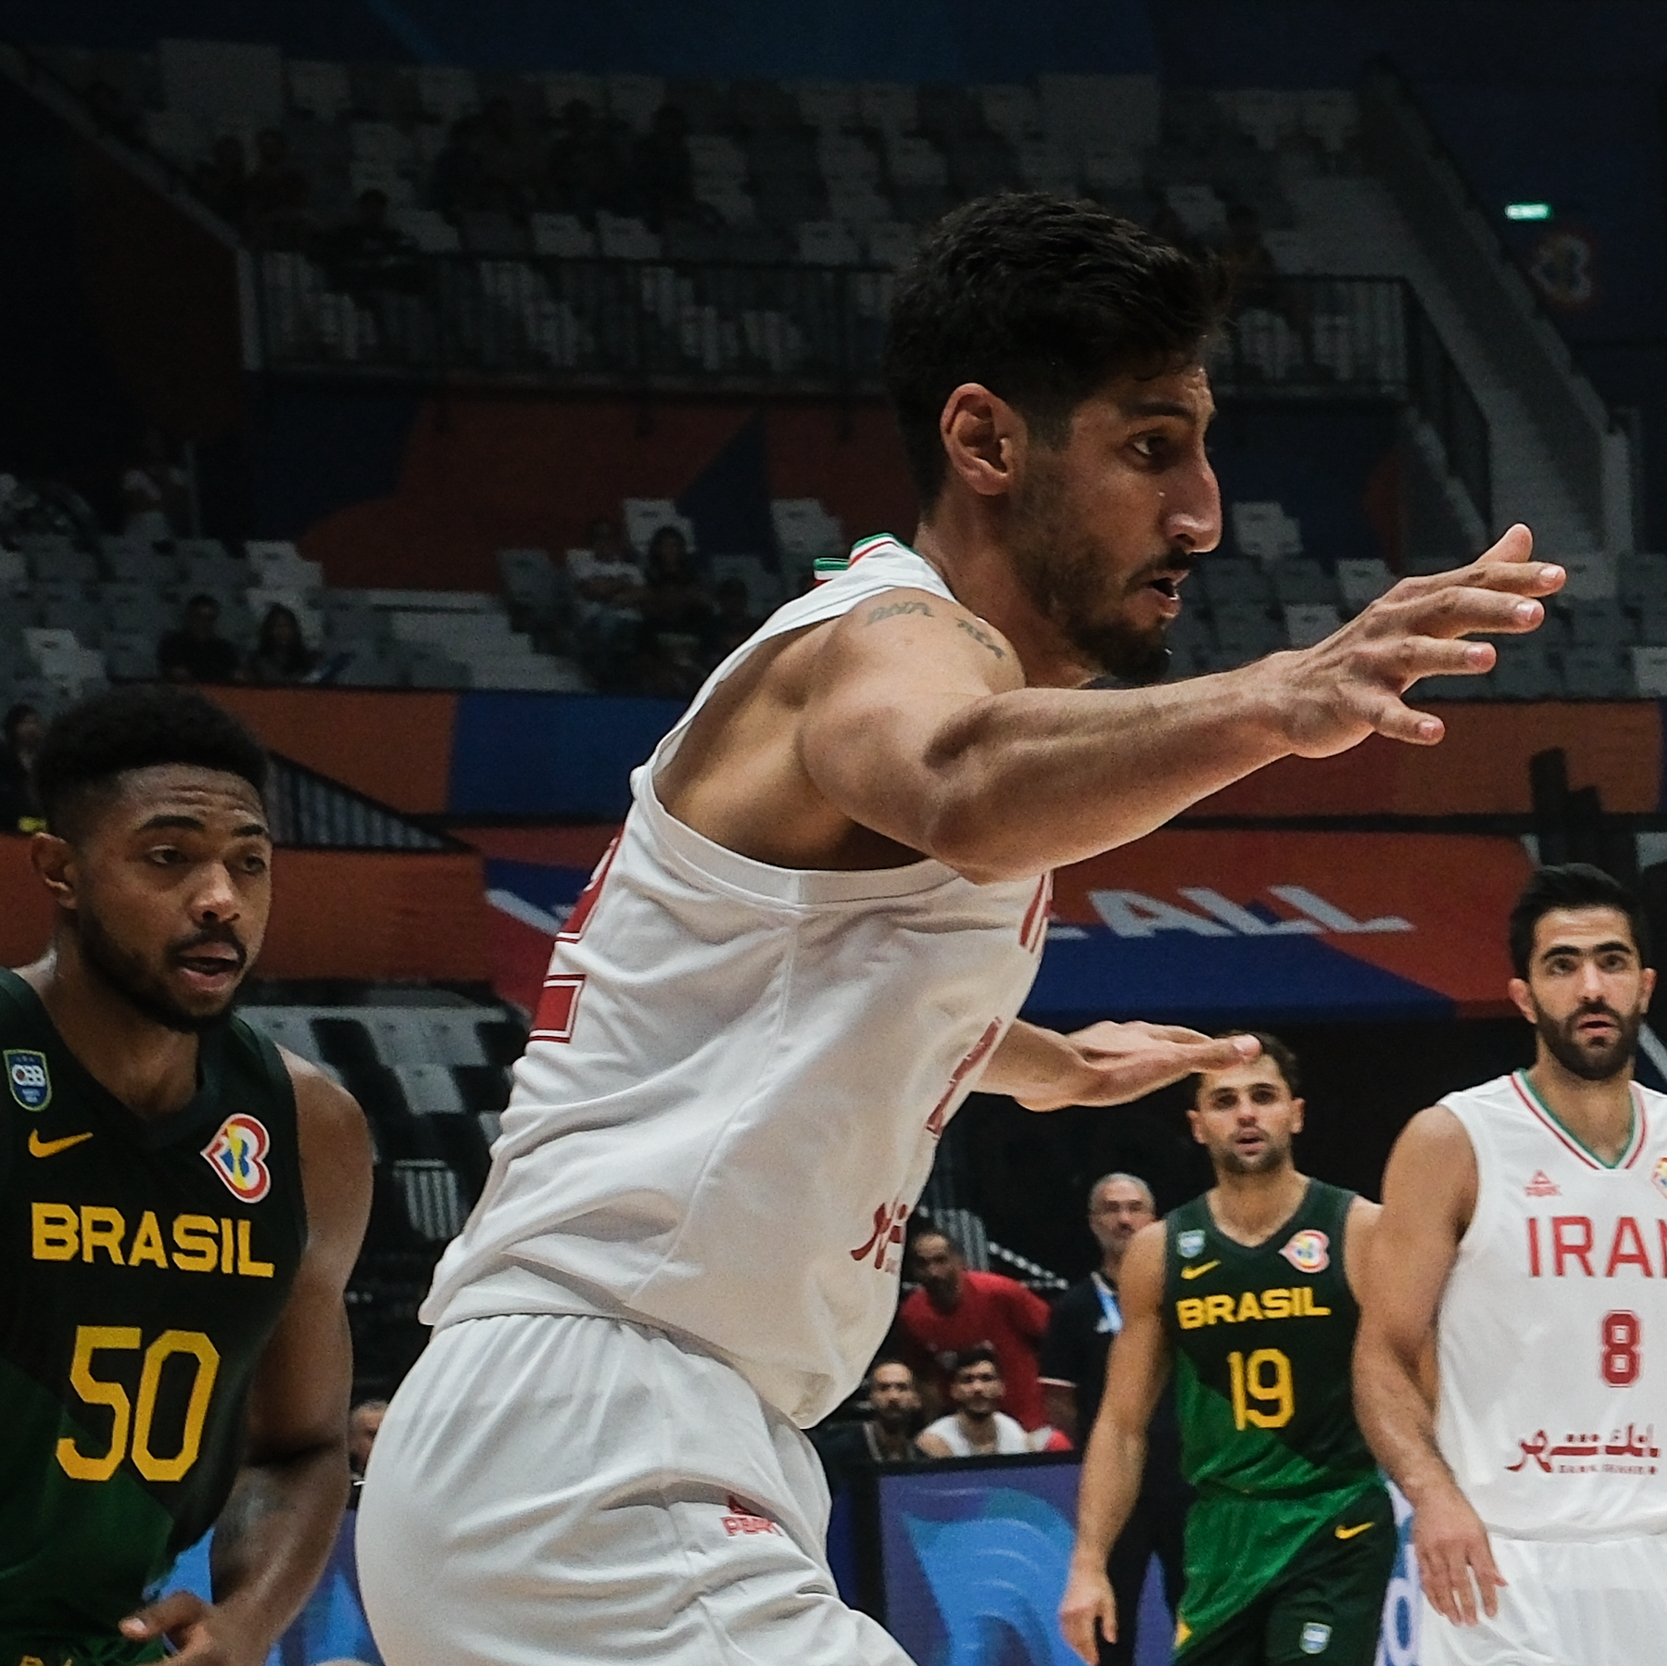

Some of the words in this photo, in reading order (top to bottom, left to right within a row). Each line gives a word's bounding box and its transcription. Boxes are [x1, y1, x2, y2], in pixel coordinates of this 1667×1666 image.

[1088, 885, 1416, 939] ALL
[31, 1202, 275, 1279] BRASIL
[1176, 1286, 1331, 1330] BRASIL
[1601, 1311, 1642, 1388] 8
[55, 1325, 221, 1483] 50
[1228, 1349, 1295, 1431] 19
